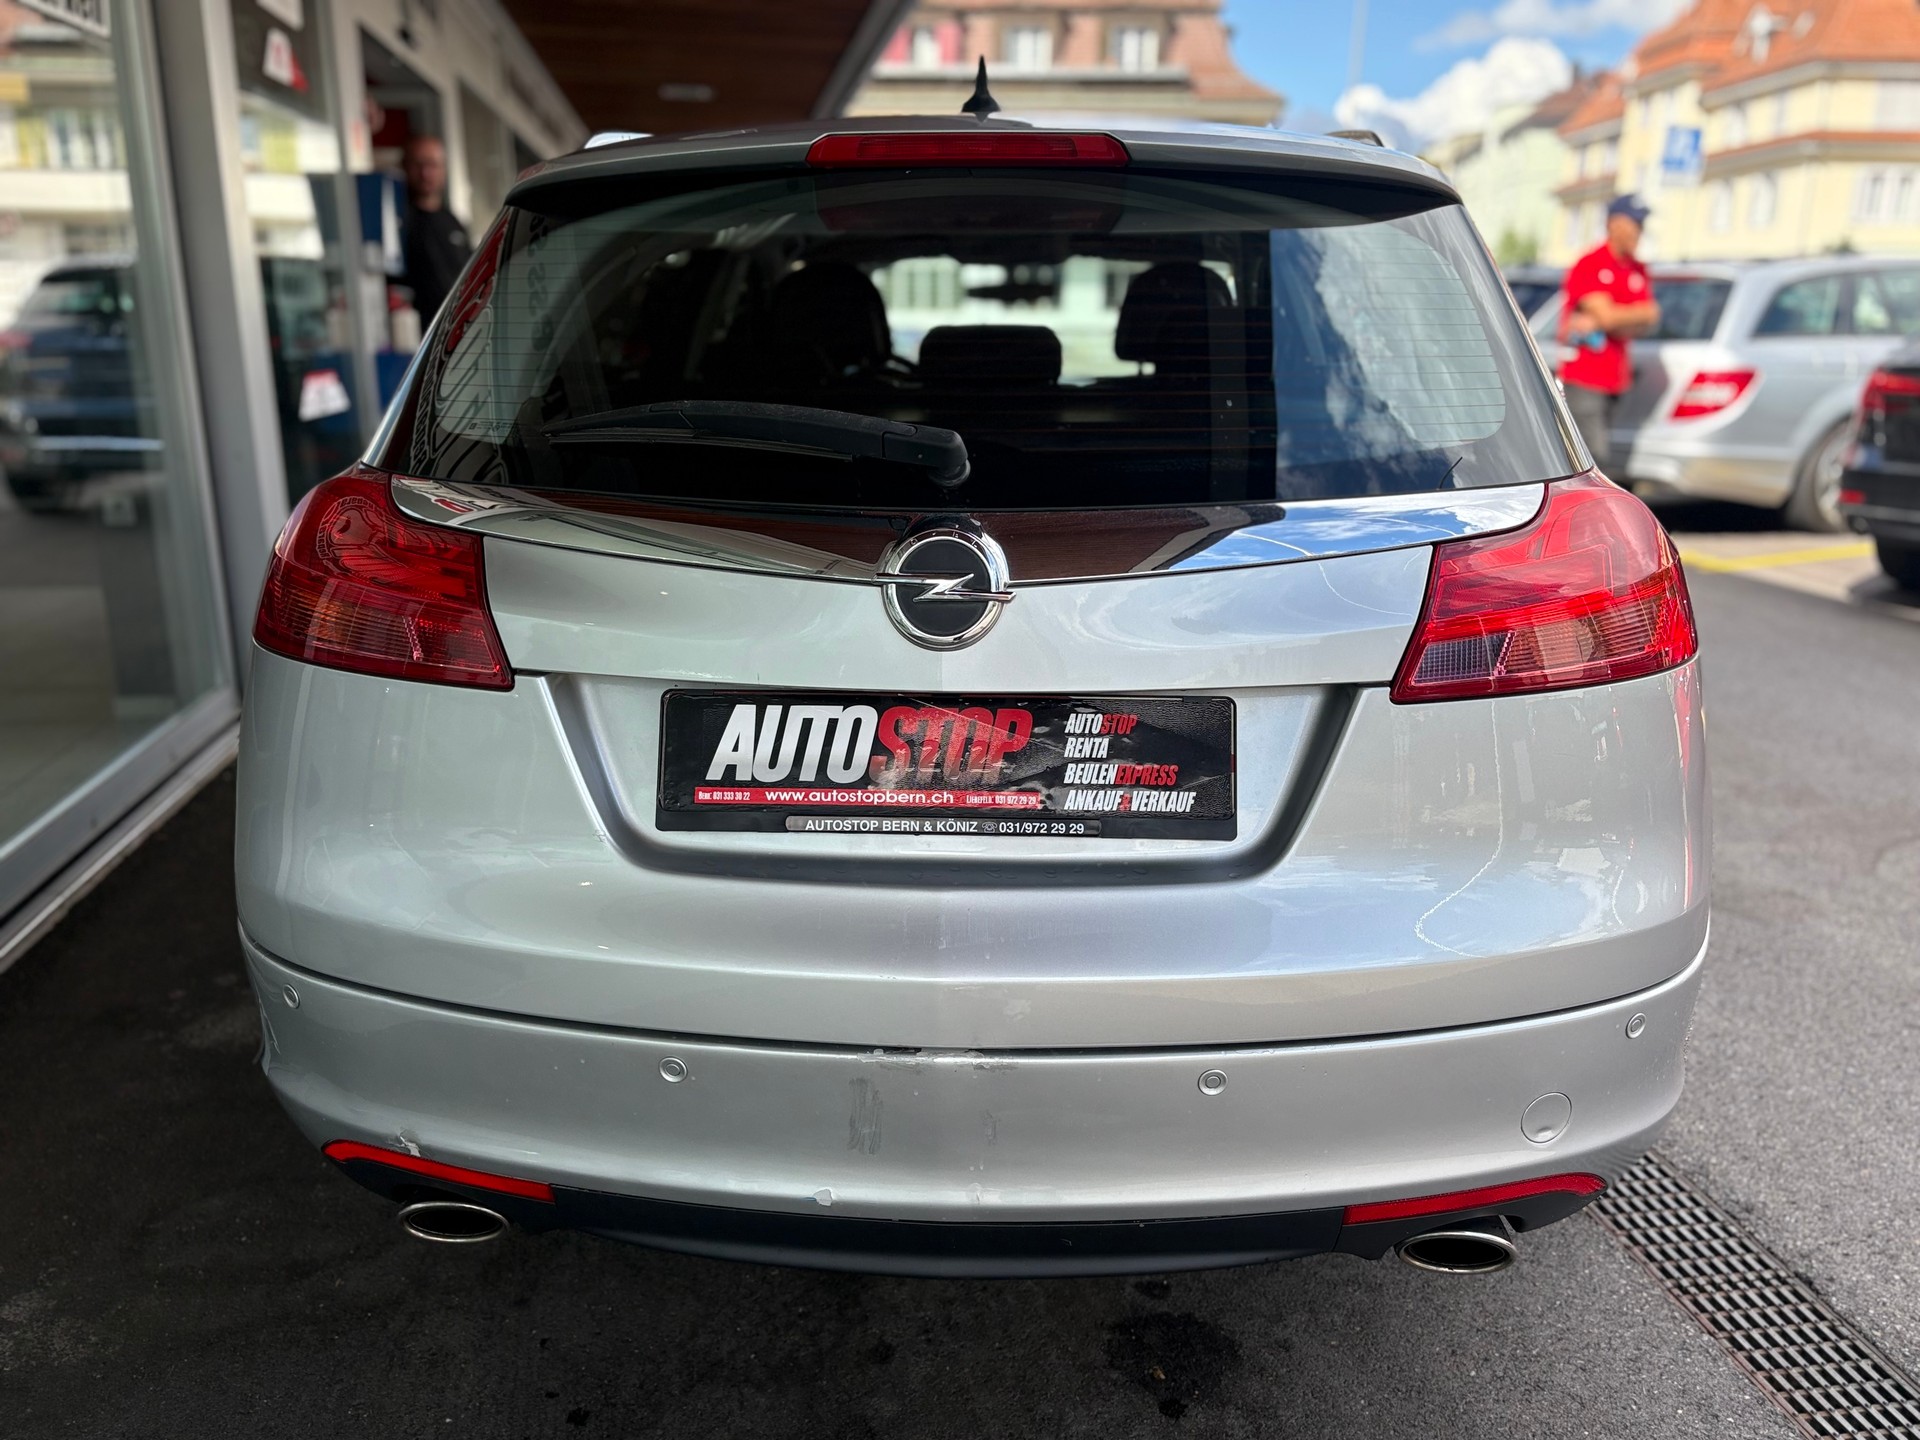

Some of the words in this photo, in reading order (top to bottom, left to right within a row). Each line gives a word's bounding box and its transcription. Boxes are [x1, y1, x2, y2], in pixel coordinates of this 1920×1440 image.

[1064, 713, 1138, 735] AUTOSTOP
[705, 704, 1034, 785] AUTOSTOP
[1063, 737, 1110, 759] RENTA
[1063, 763, 1179, 786] BEULENEXPRESS
[765, 789, 954, 805] www.autostopbern.ch
[805, 819, 879, 832] AUTOSTOP
[882, 820, 920, 832] BERN
[923, 820, 933, 833] &
[936, 819, 978, 833] KÖNIZ
[998, 821, 1048, 834] 031/972
[1050, 823, 1067, 834] 29
[1068, 823, 1085, 835] 29
